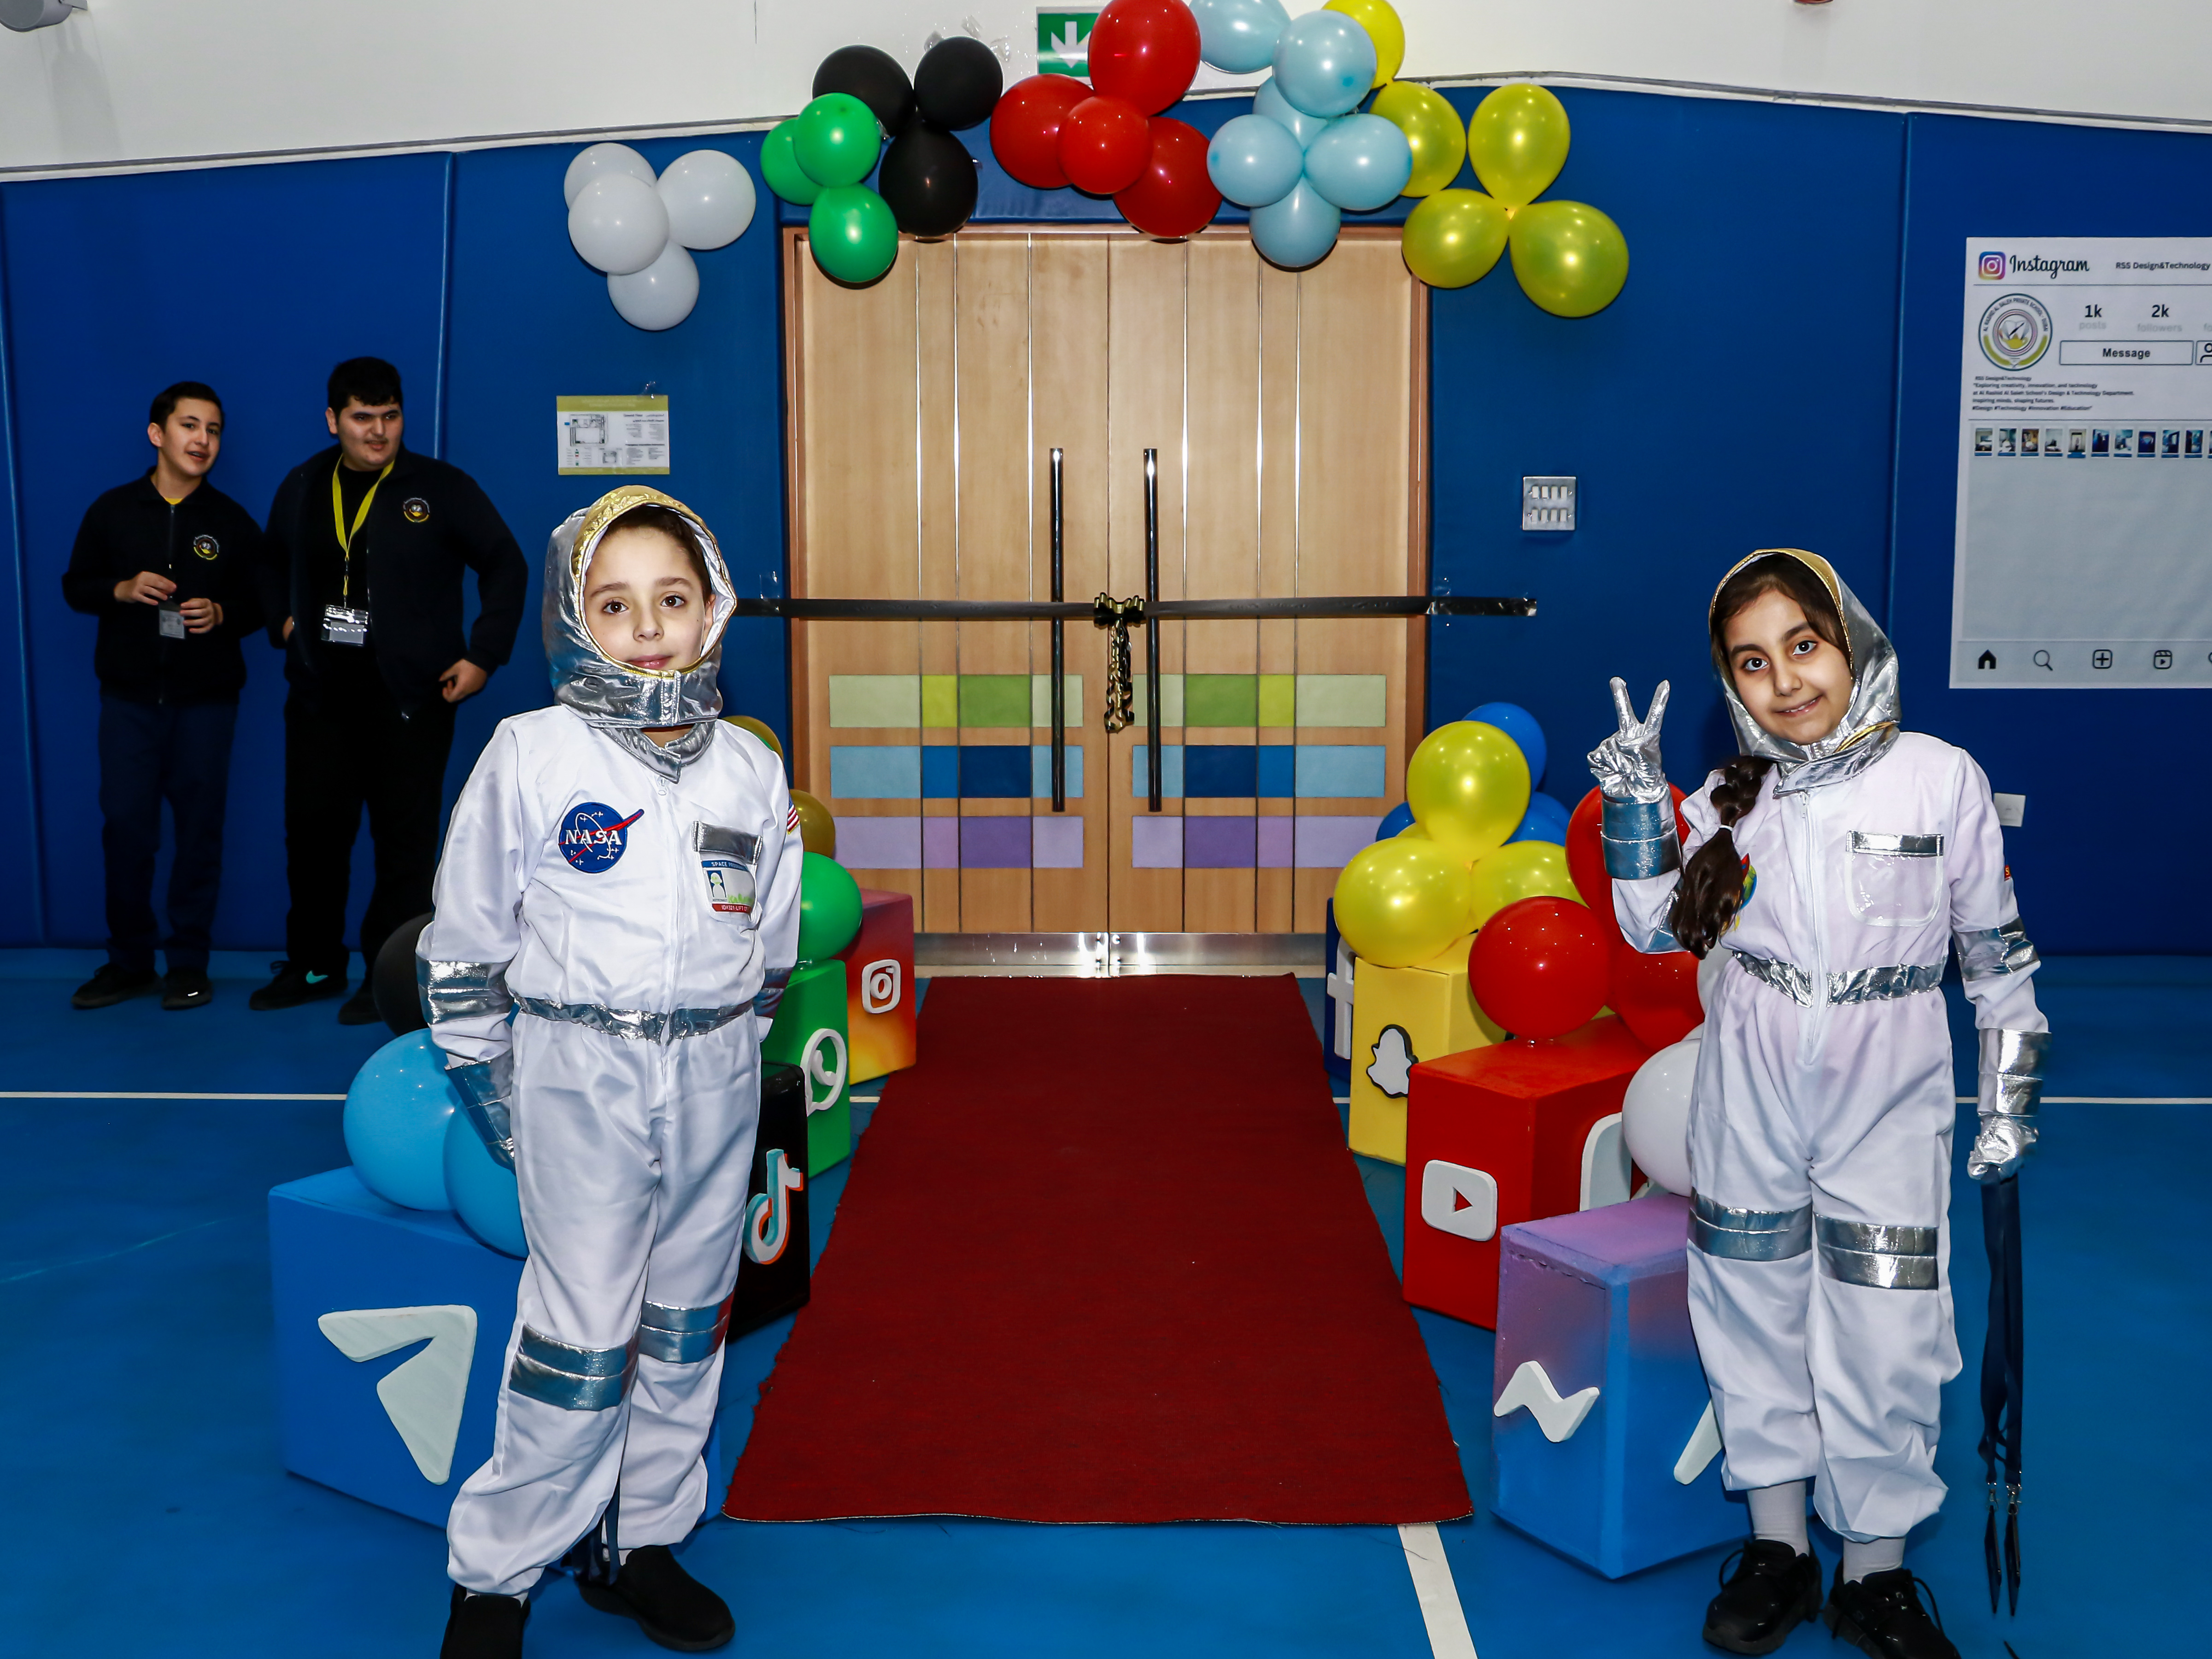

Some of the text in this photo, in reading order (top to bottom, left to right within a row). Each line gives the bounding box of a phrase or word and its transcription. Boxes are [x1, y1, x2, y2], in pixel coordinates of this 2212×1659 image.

[2010, 255, 2090, 279] Instagram
[2133, 262, 2211, 270] Design&Technology
[2084, 304, 2102, 317] 1k
[2152, 304, 2170, 317] 2k
[2079, 321, 2106, 331] posts
[2137, 323, 2182, 332] followers
[2102, 348, 2151, 359] Message
[565, 829, 622, 845] NASA
